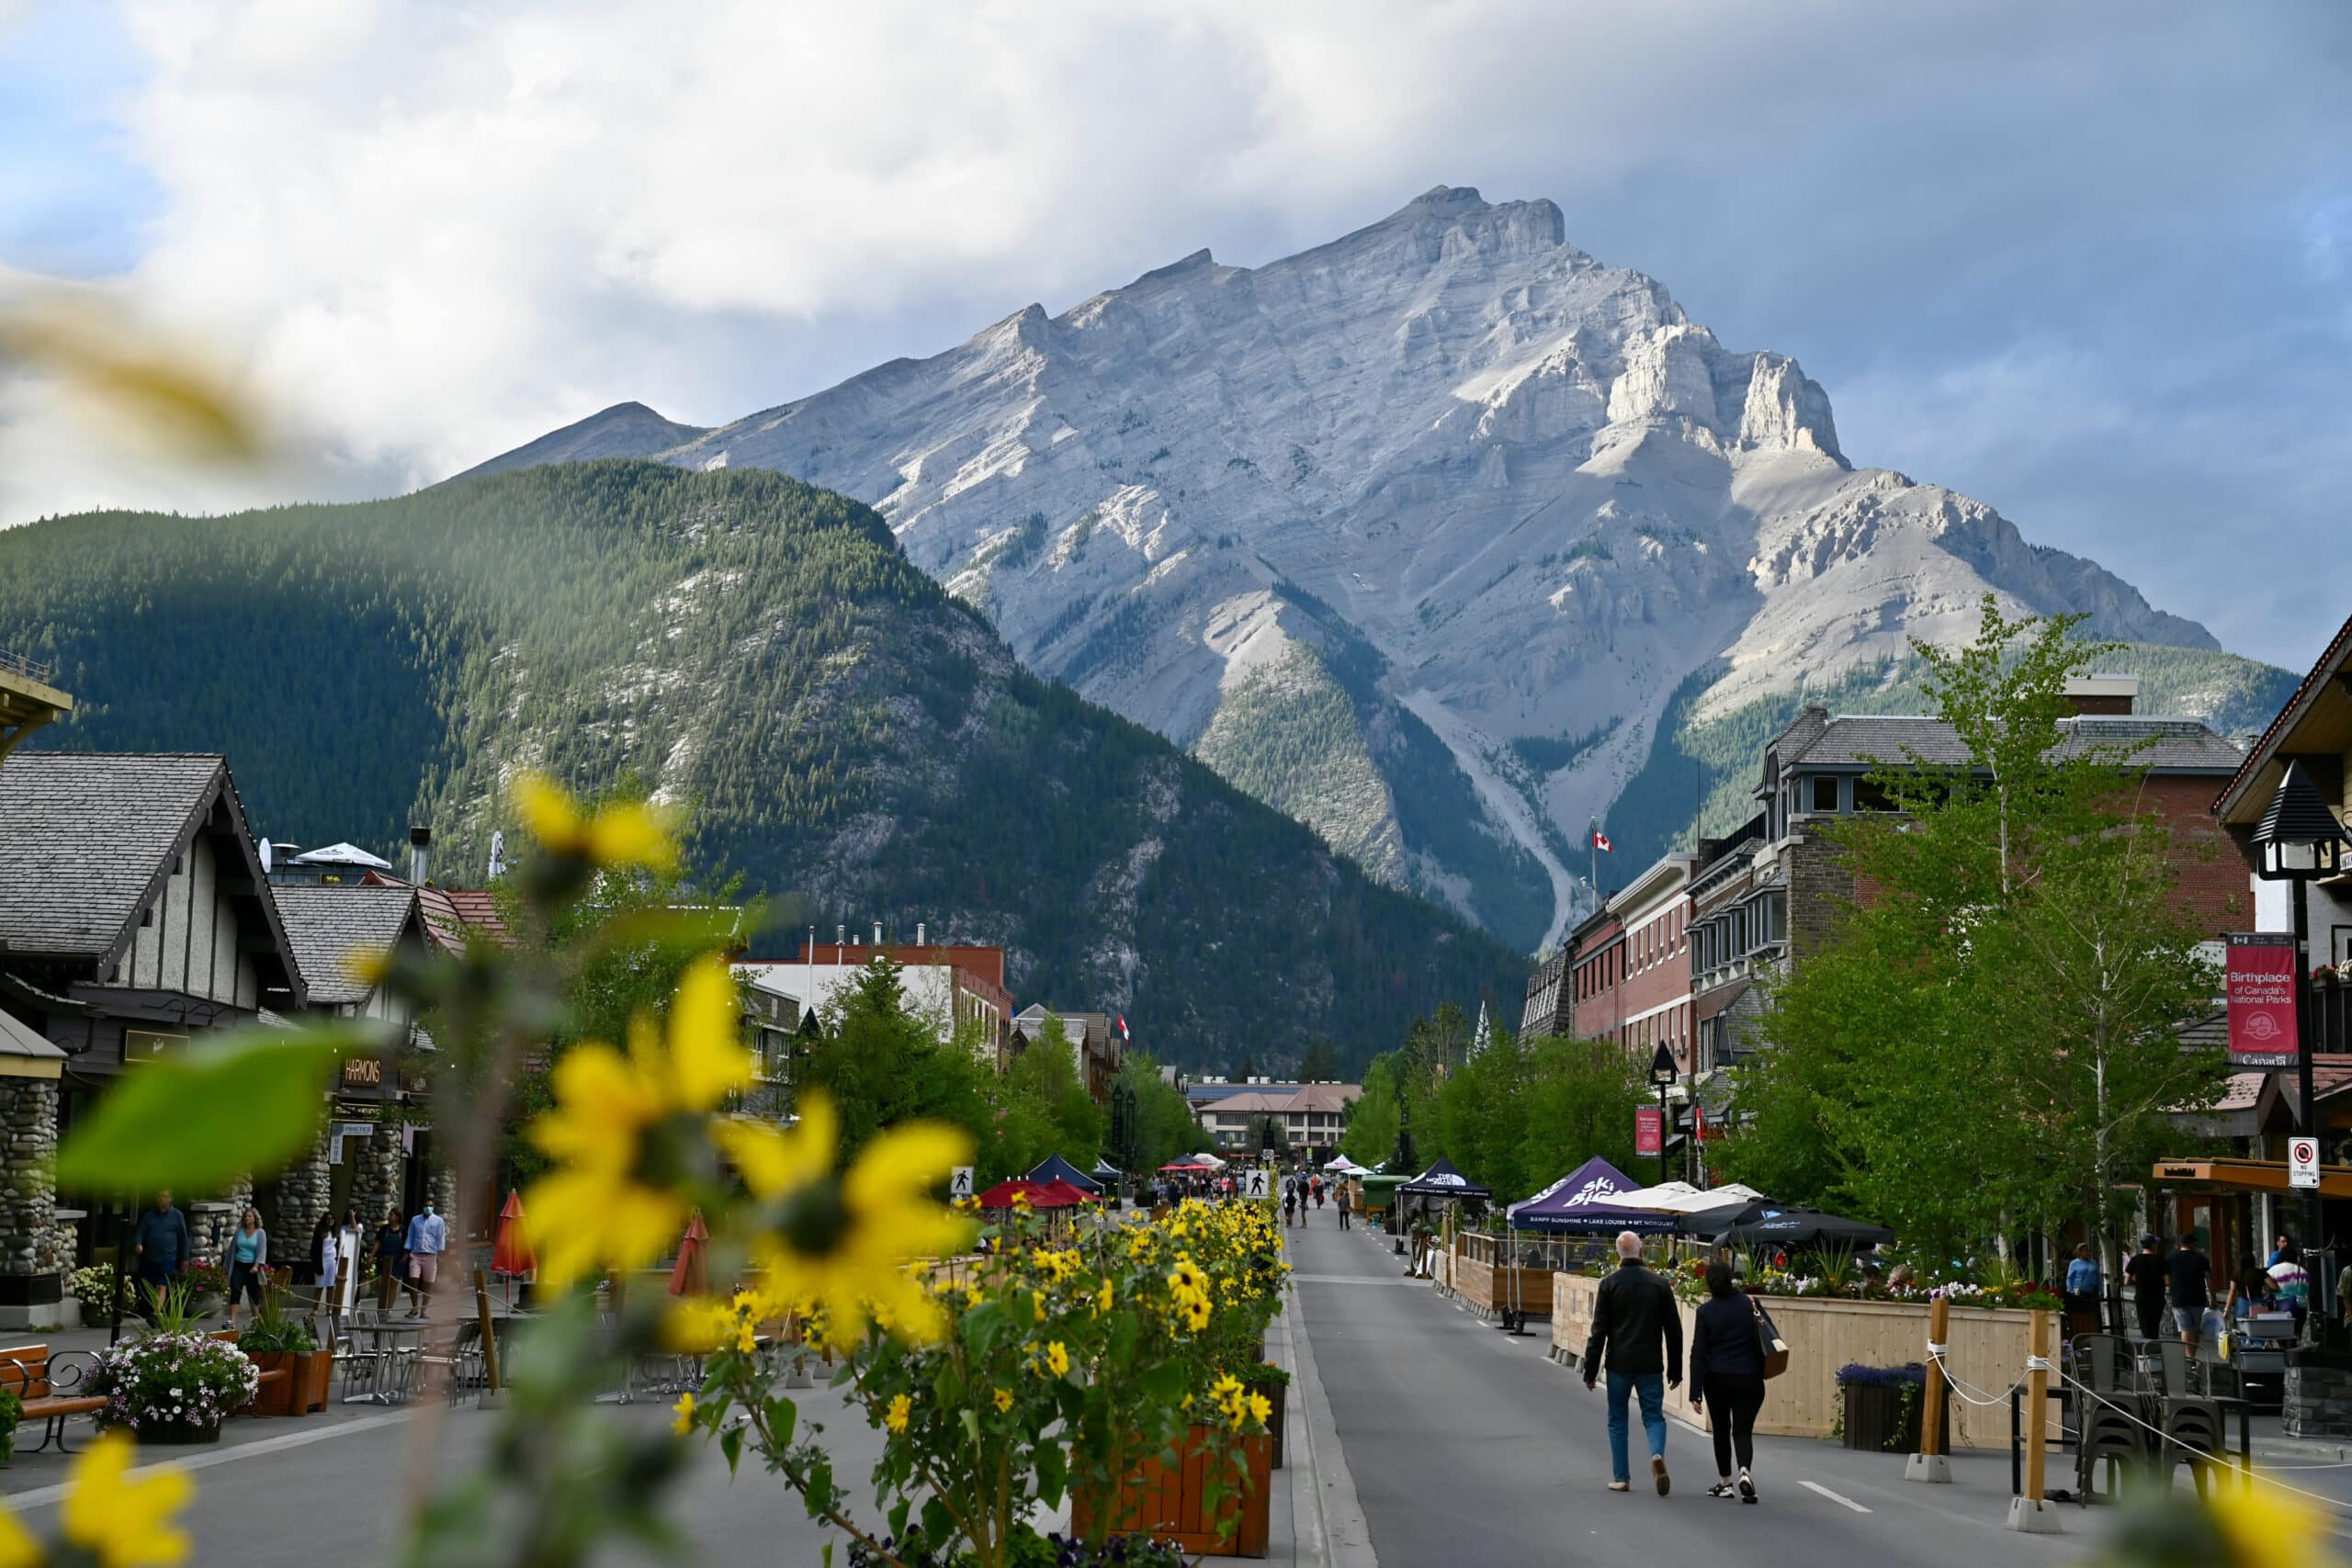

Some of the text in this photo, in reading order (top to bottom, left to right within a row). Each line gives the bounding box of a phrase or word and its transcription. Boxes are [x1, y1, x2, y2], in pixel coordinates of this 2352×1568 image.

[2230, 971, 2290, 986] Birthplace
[2234, 986, 2286, 995] of Canada's
[2230, 995, 2292, 1004] National Parks
[2243, 1055, 2287, 1066] Canada
[345, 1057, 380, 1083] HARMONS
